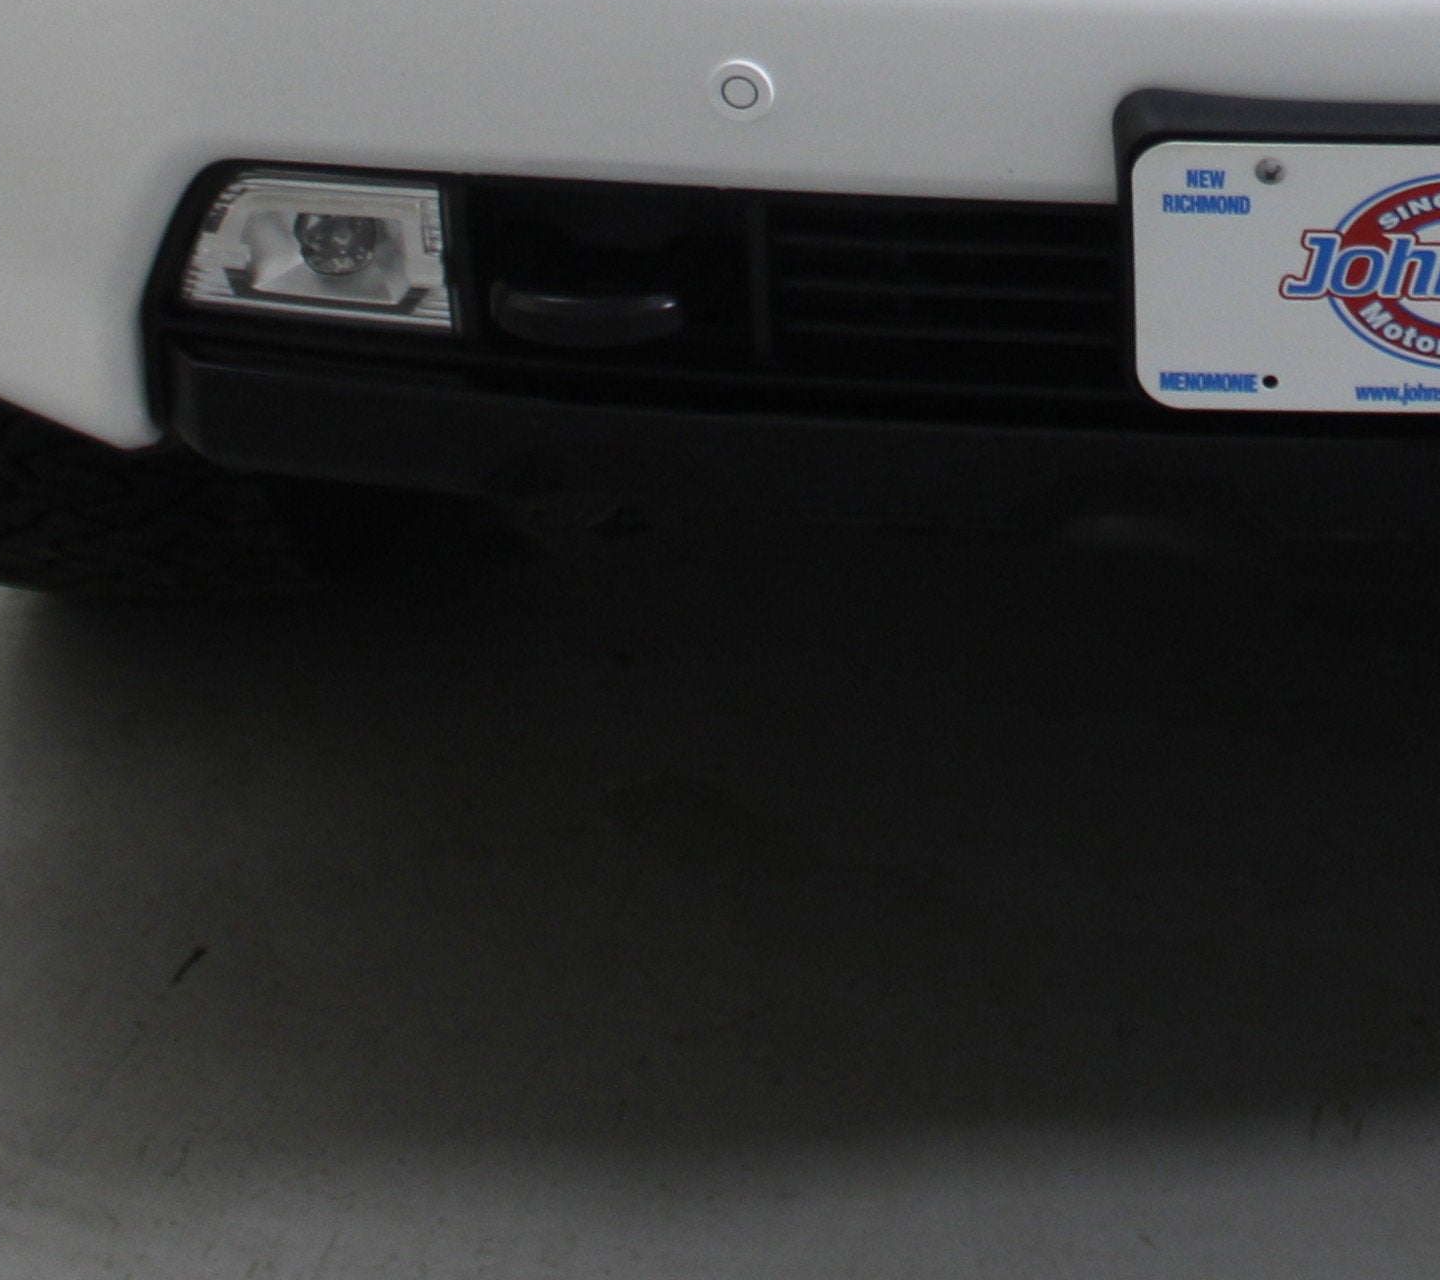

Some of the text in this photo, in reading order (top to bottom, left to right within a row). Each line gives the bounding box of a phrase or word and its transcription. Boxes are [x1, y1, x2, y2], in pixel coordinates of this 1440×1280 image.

[1186, 169, 1225, 189] NEW
[1162, 193, 1252, 216] RICHMOND
[1159, 372, 1259, 394] MENOMONIE
